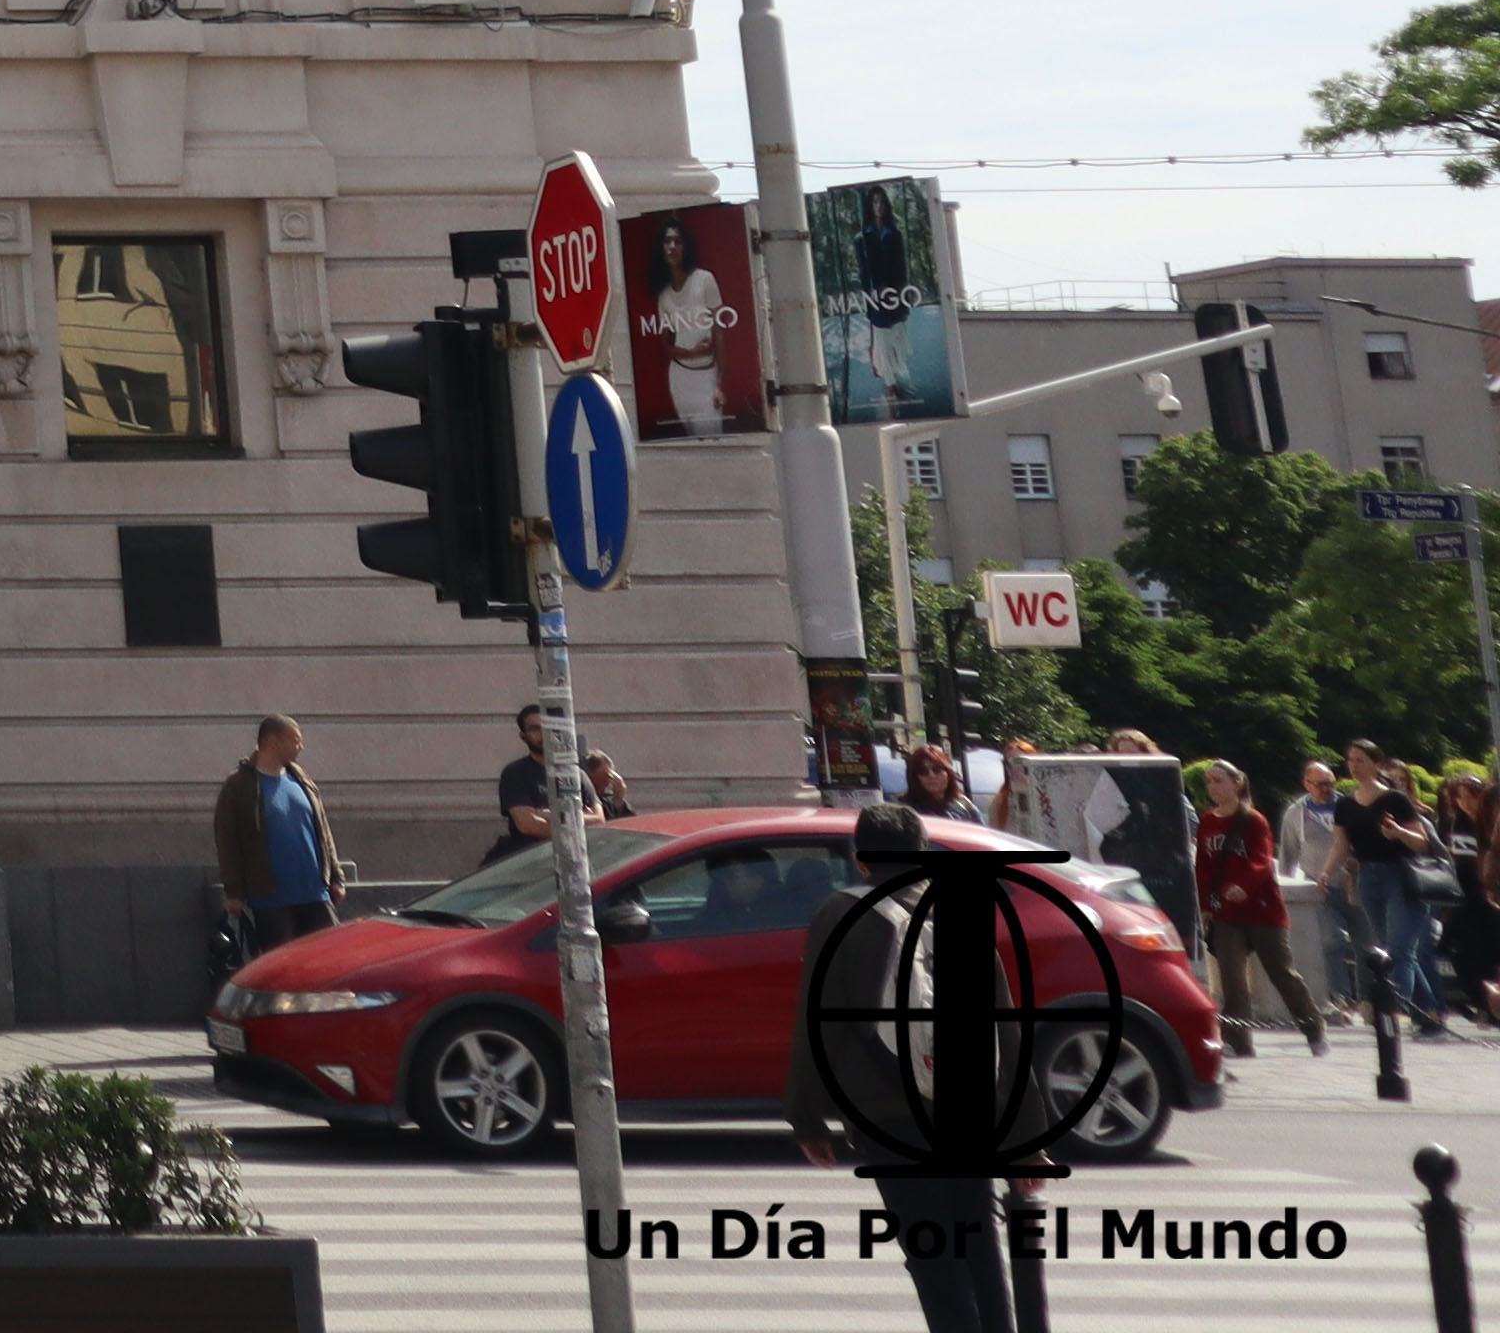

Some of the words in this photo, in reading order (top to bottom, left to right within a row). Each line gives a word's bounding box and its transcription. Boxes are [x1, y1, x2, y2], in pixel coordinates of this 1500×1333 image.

[539, 225, 598, 303] STOP
[827, 285, 922, 317] MANGO
[639, 306, 739, 337] MANGO
[1003, 591, 1070, 628] WC
